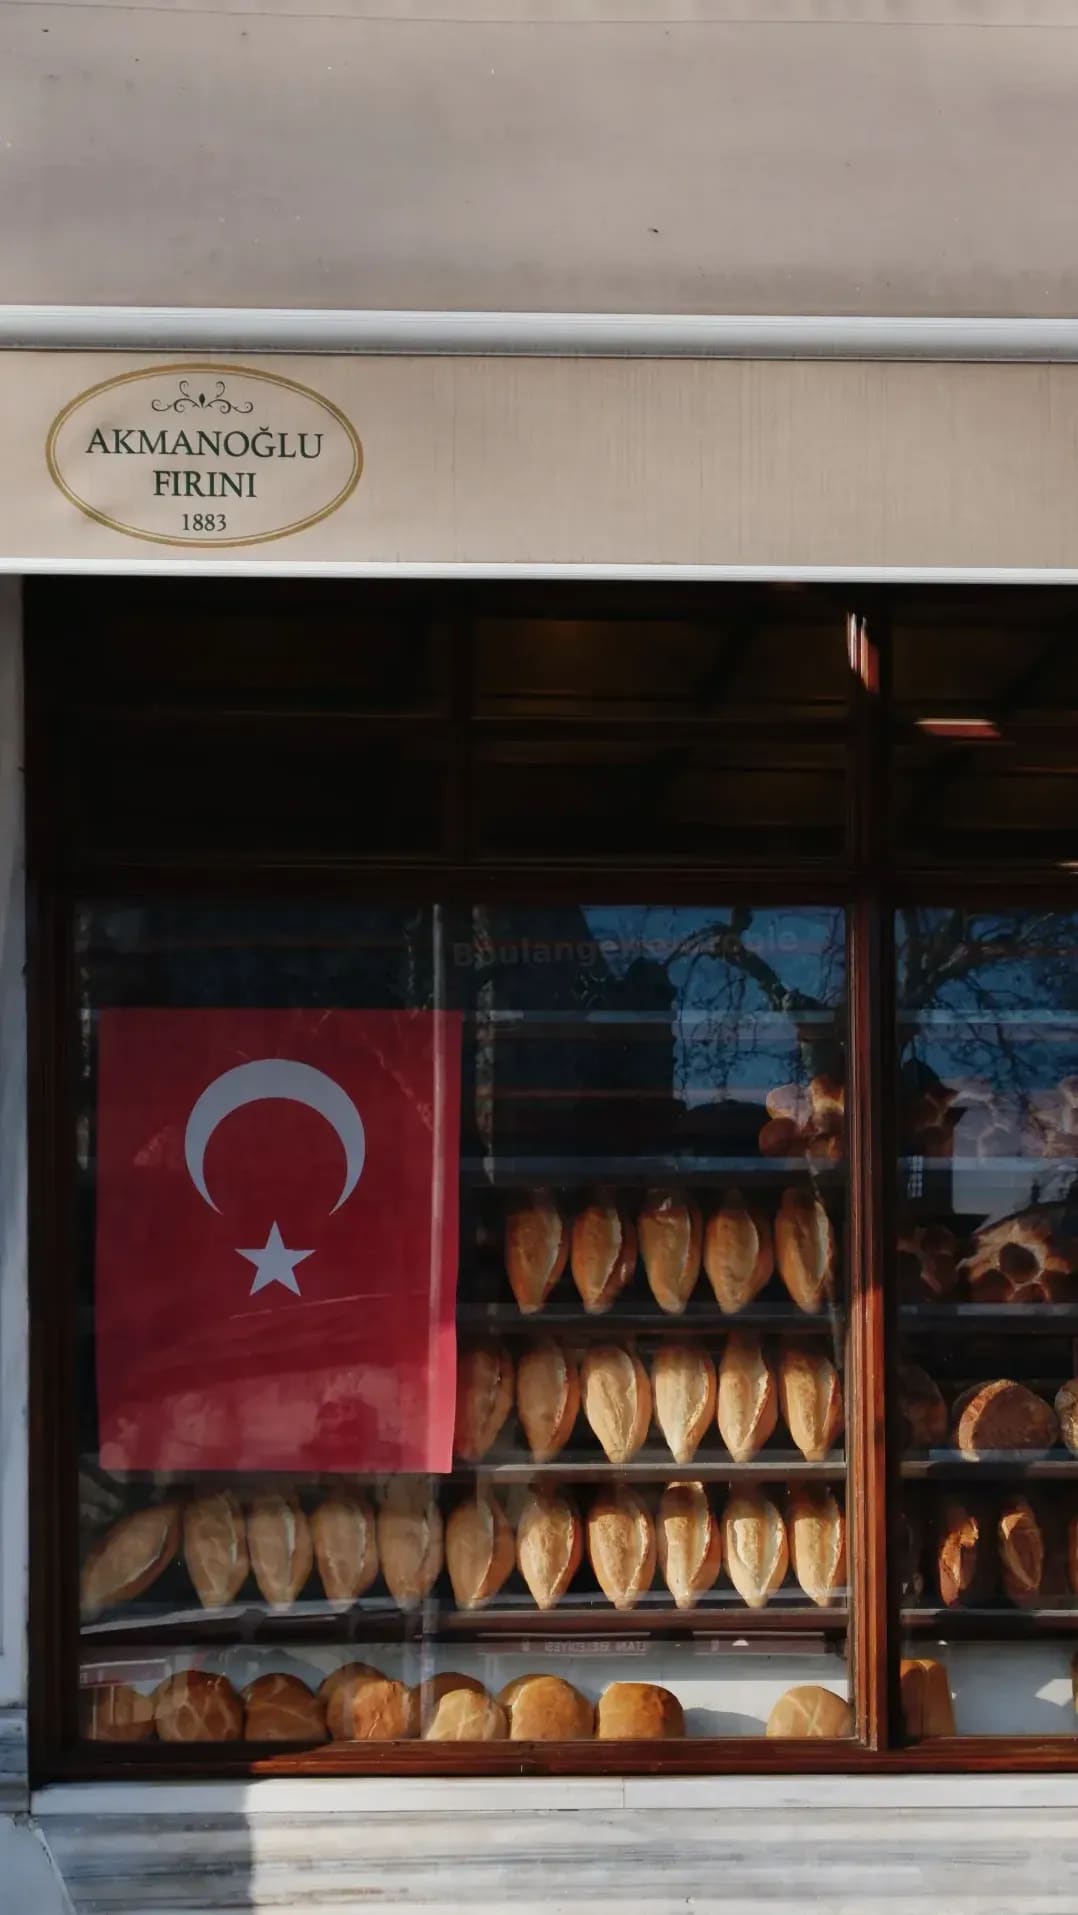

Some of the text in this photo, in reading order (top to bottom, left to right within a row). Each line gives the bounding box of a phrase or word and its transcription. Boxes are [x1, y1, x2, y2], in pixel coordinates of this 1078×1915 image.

[85, 426, 324, 459] AKMANOĞLU
[152, 470, 257, 498] FIRINI
[182, 513, 227, 531] 1883
